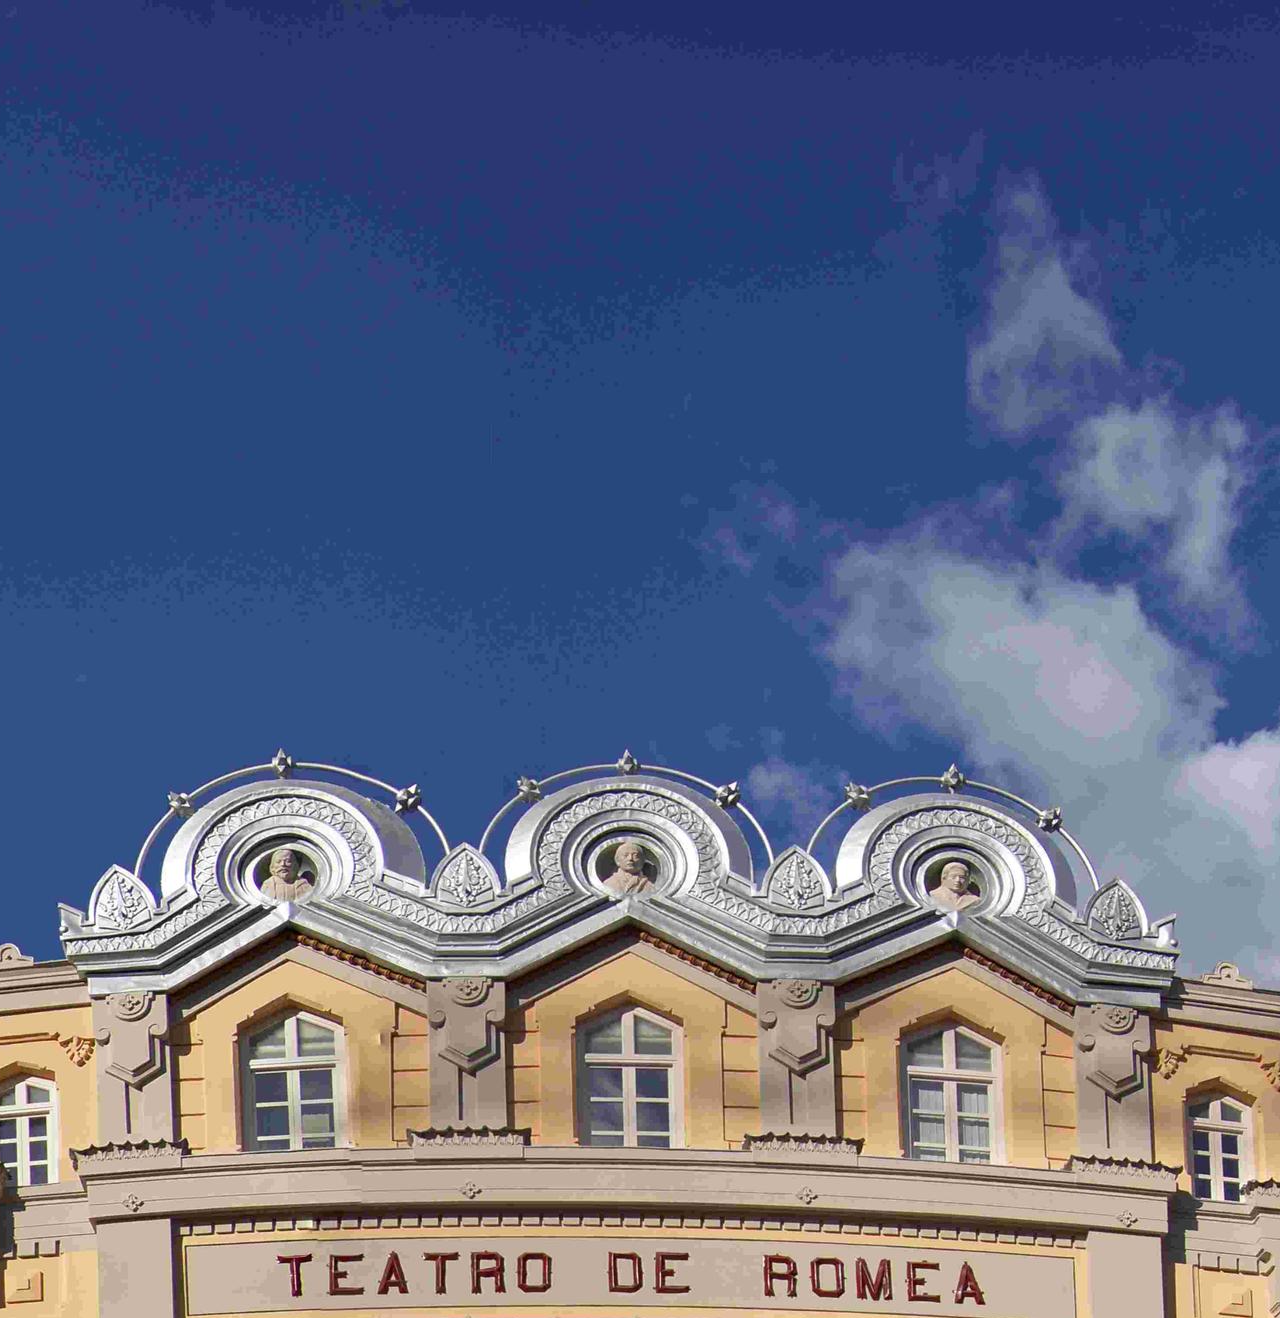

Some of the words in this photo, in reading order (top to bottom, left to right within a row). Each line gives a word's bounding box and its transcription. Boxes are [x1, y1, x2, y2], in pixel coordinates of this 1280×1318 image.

[275, 1250, 553, 1298] TEATRO
[607, 1250, 692, 1295] DE
[763, 1254, 987, 1308] ROMEA
